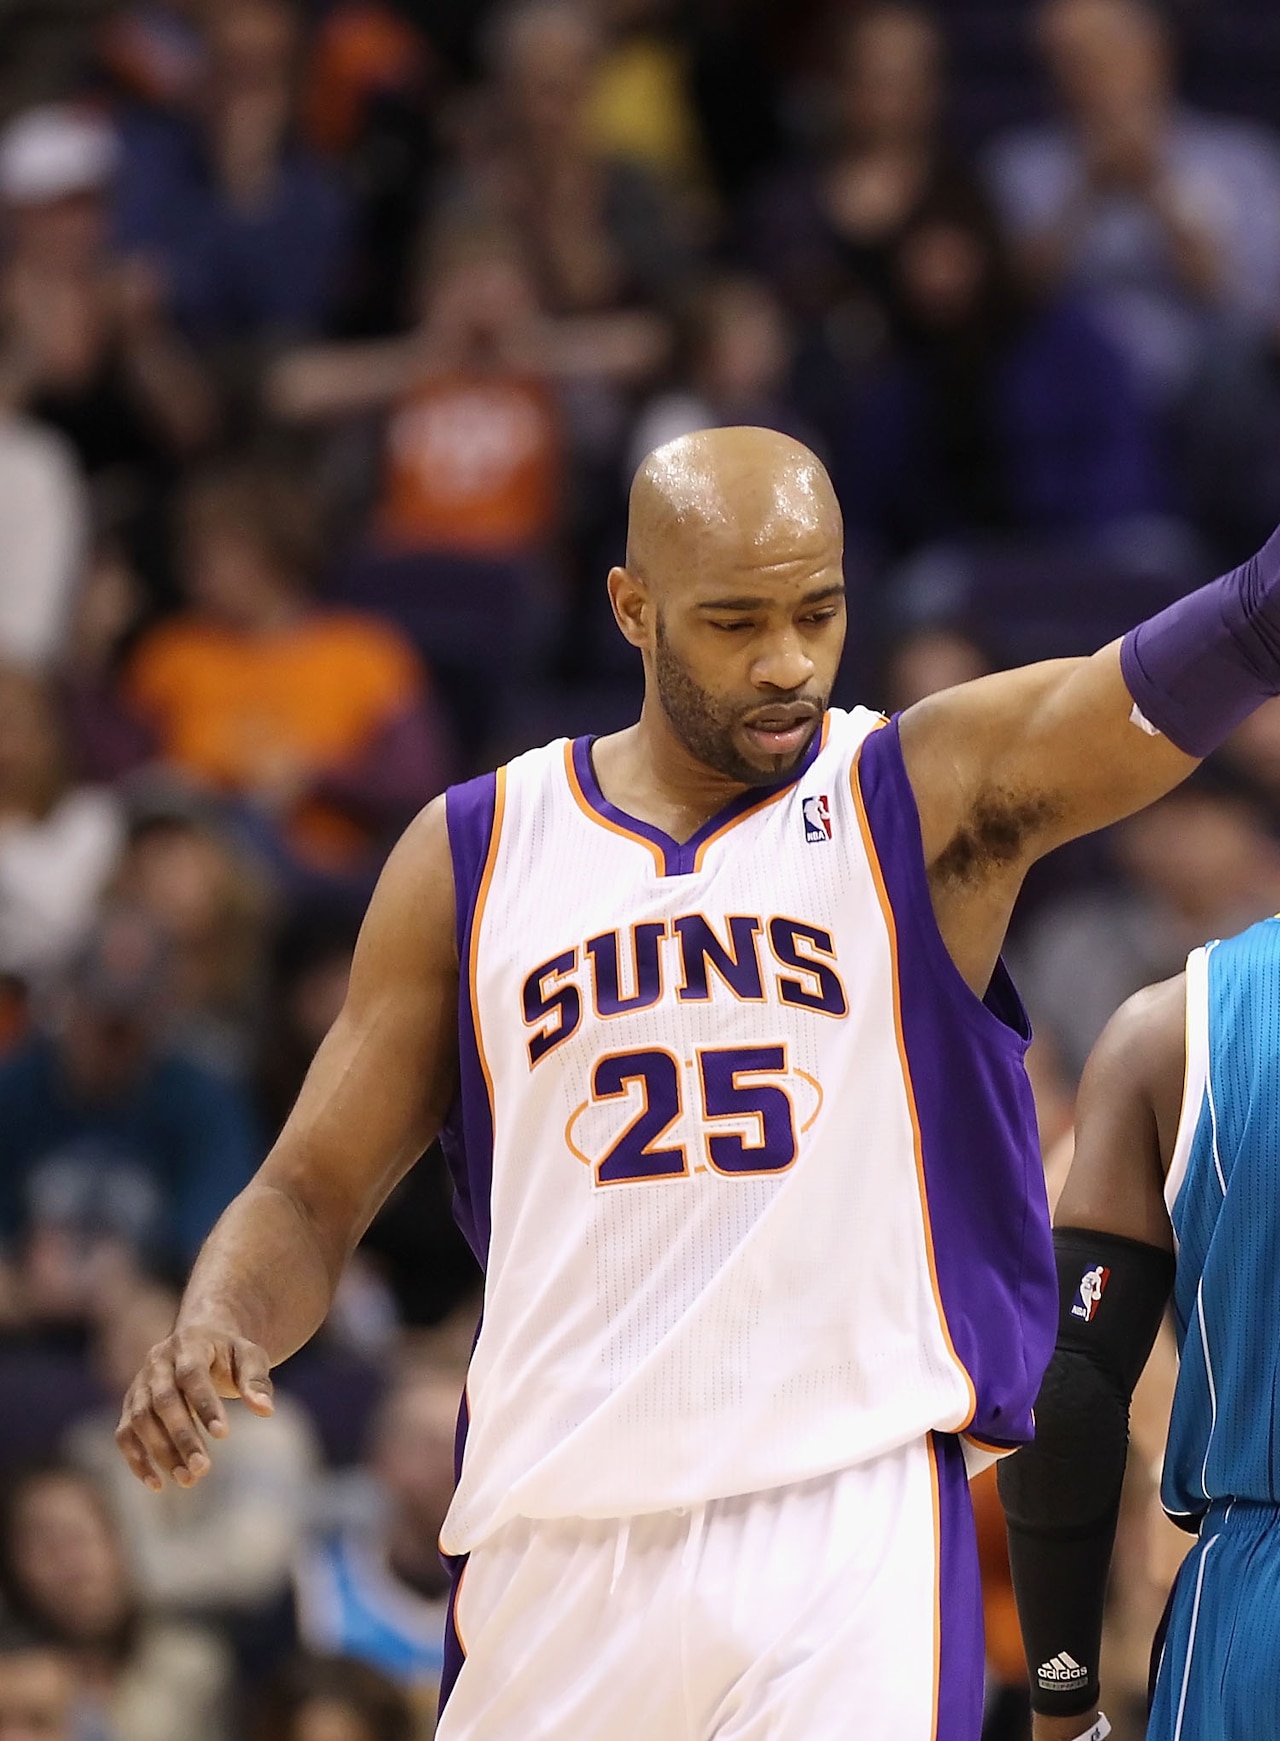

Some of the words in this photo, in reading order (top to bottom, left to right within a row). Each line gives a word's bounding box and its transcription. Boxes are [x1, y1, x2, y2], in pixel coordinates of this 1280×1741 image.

[518, 912, 850, 1071] SUNS
[590, 1042, 799, 1188] 25
[1037, 1666, 1088, 1680] adidas
